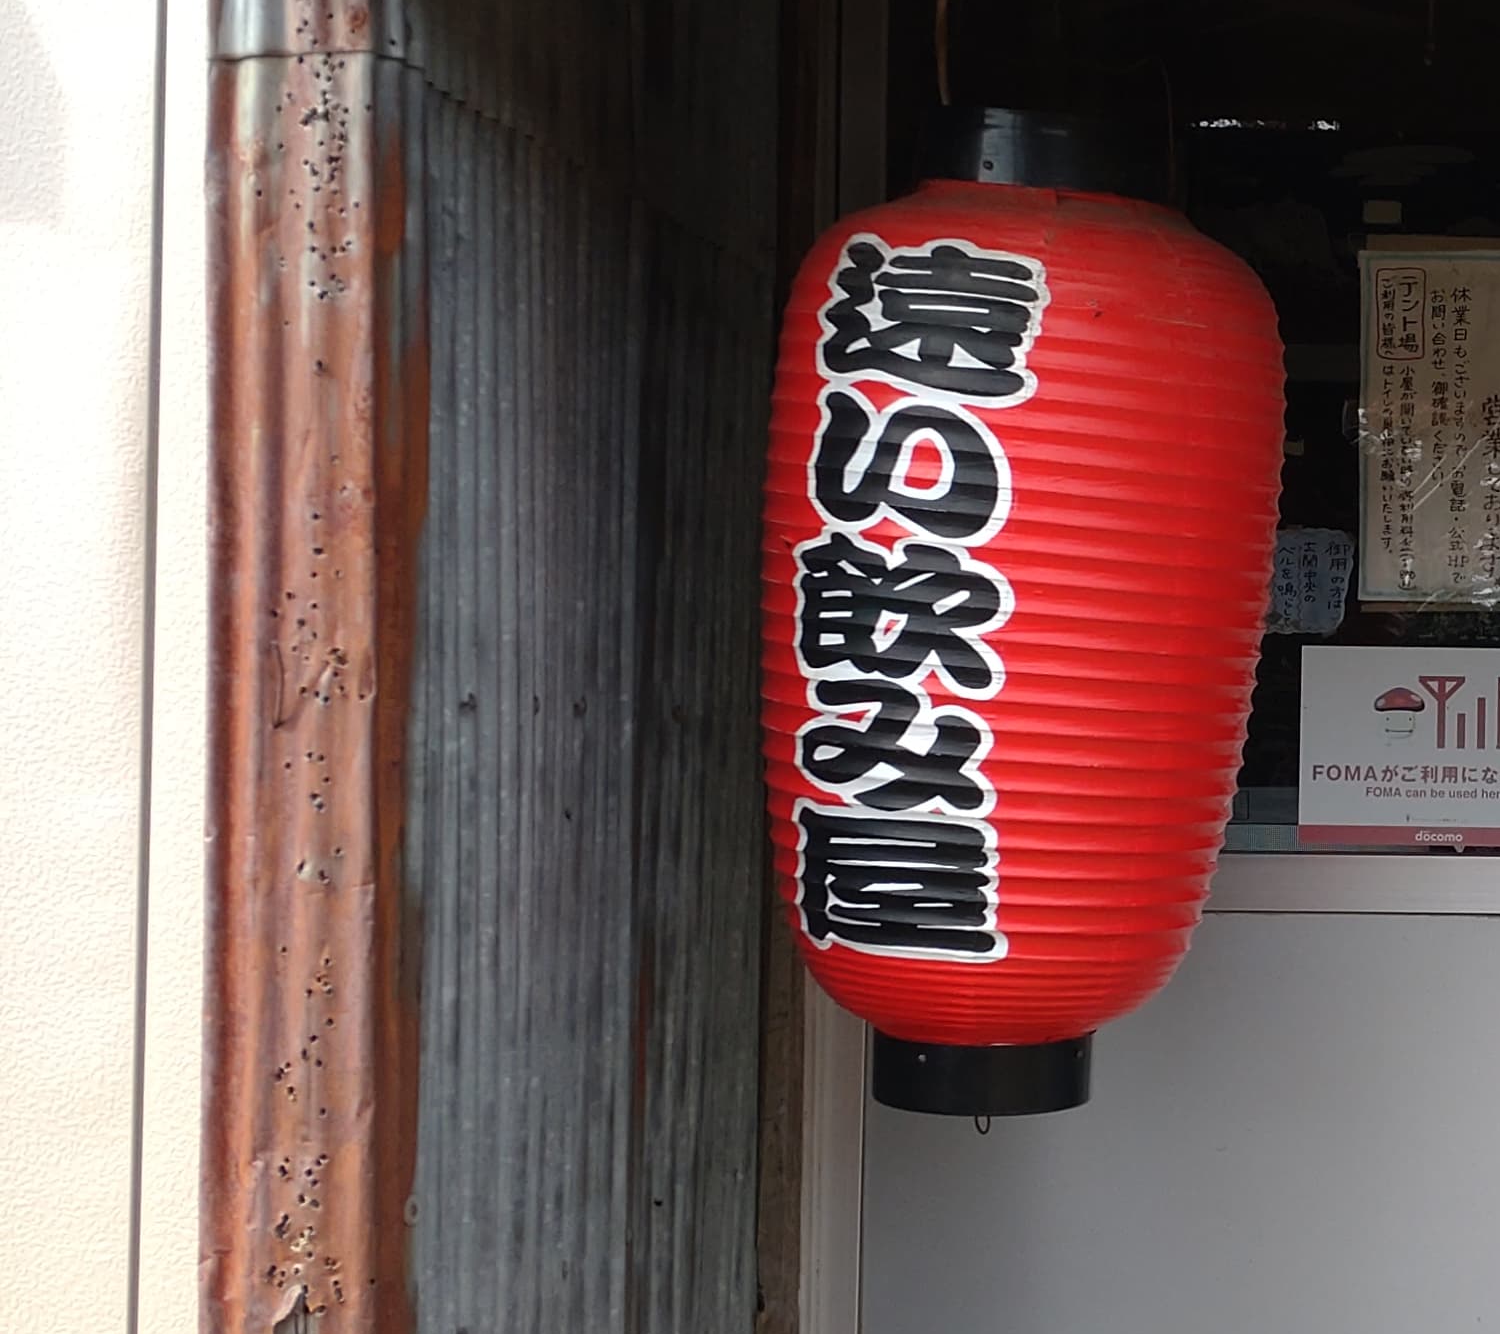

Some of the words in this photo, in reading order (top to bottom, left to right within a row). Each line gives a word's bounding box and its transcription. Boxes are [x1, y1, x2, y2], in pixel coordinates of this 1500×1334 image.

[1398, 275, 1420, 353] テント場
[797, 231, 1052, 963] 遠い飲み屋
[1365, 786, 1401, 798] FOMA
[1405, 788, 1427, 799] can
[1430, 786, 1446, 799] be
[1449, 786, 1478, 800] used
